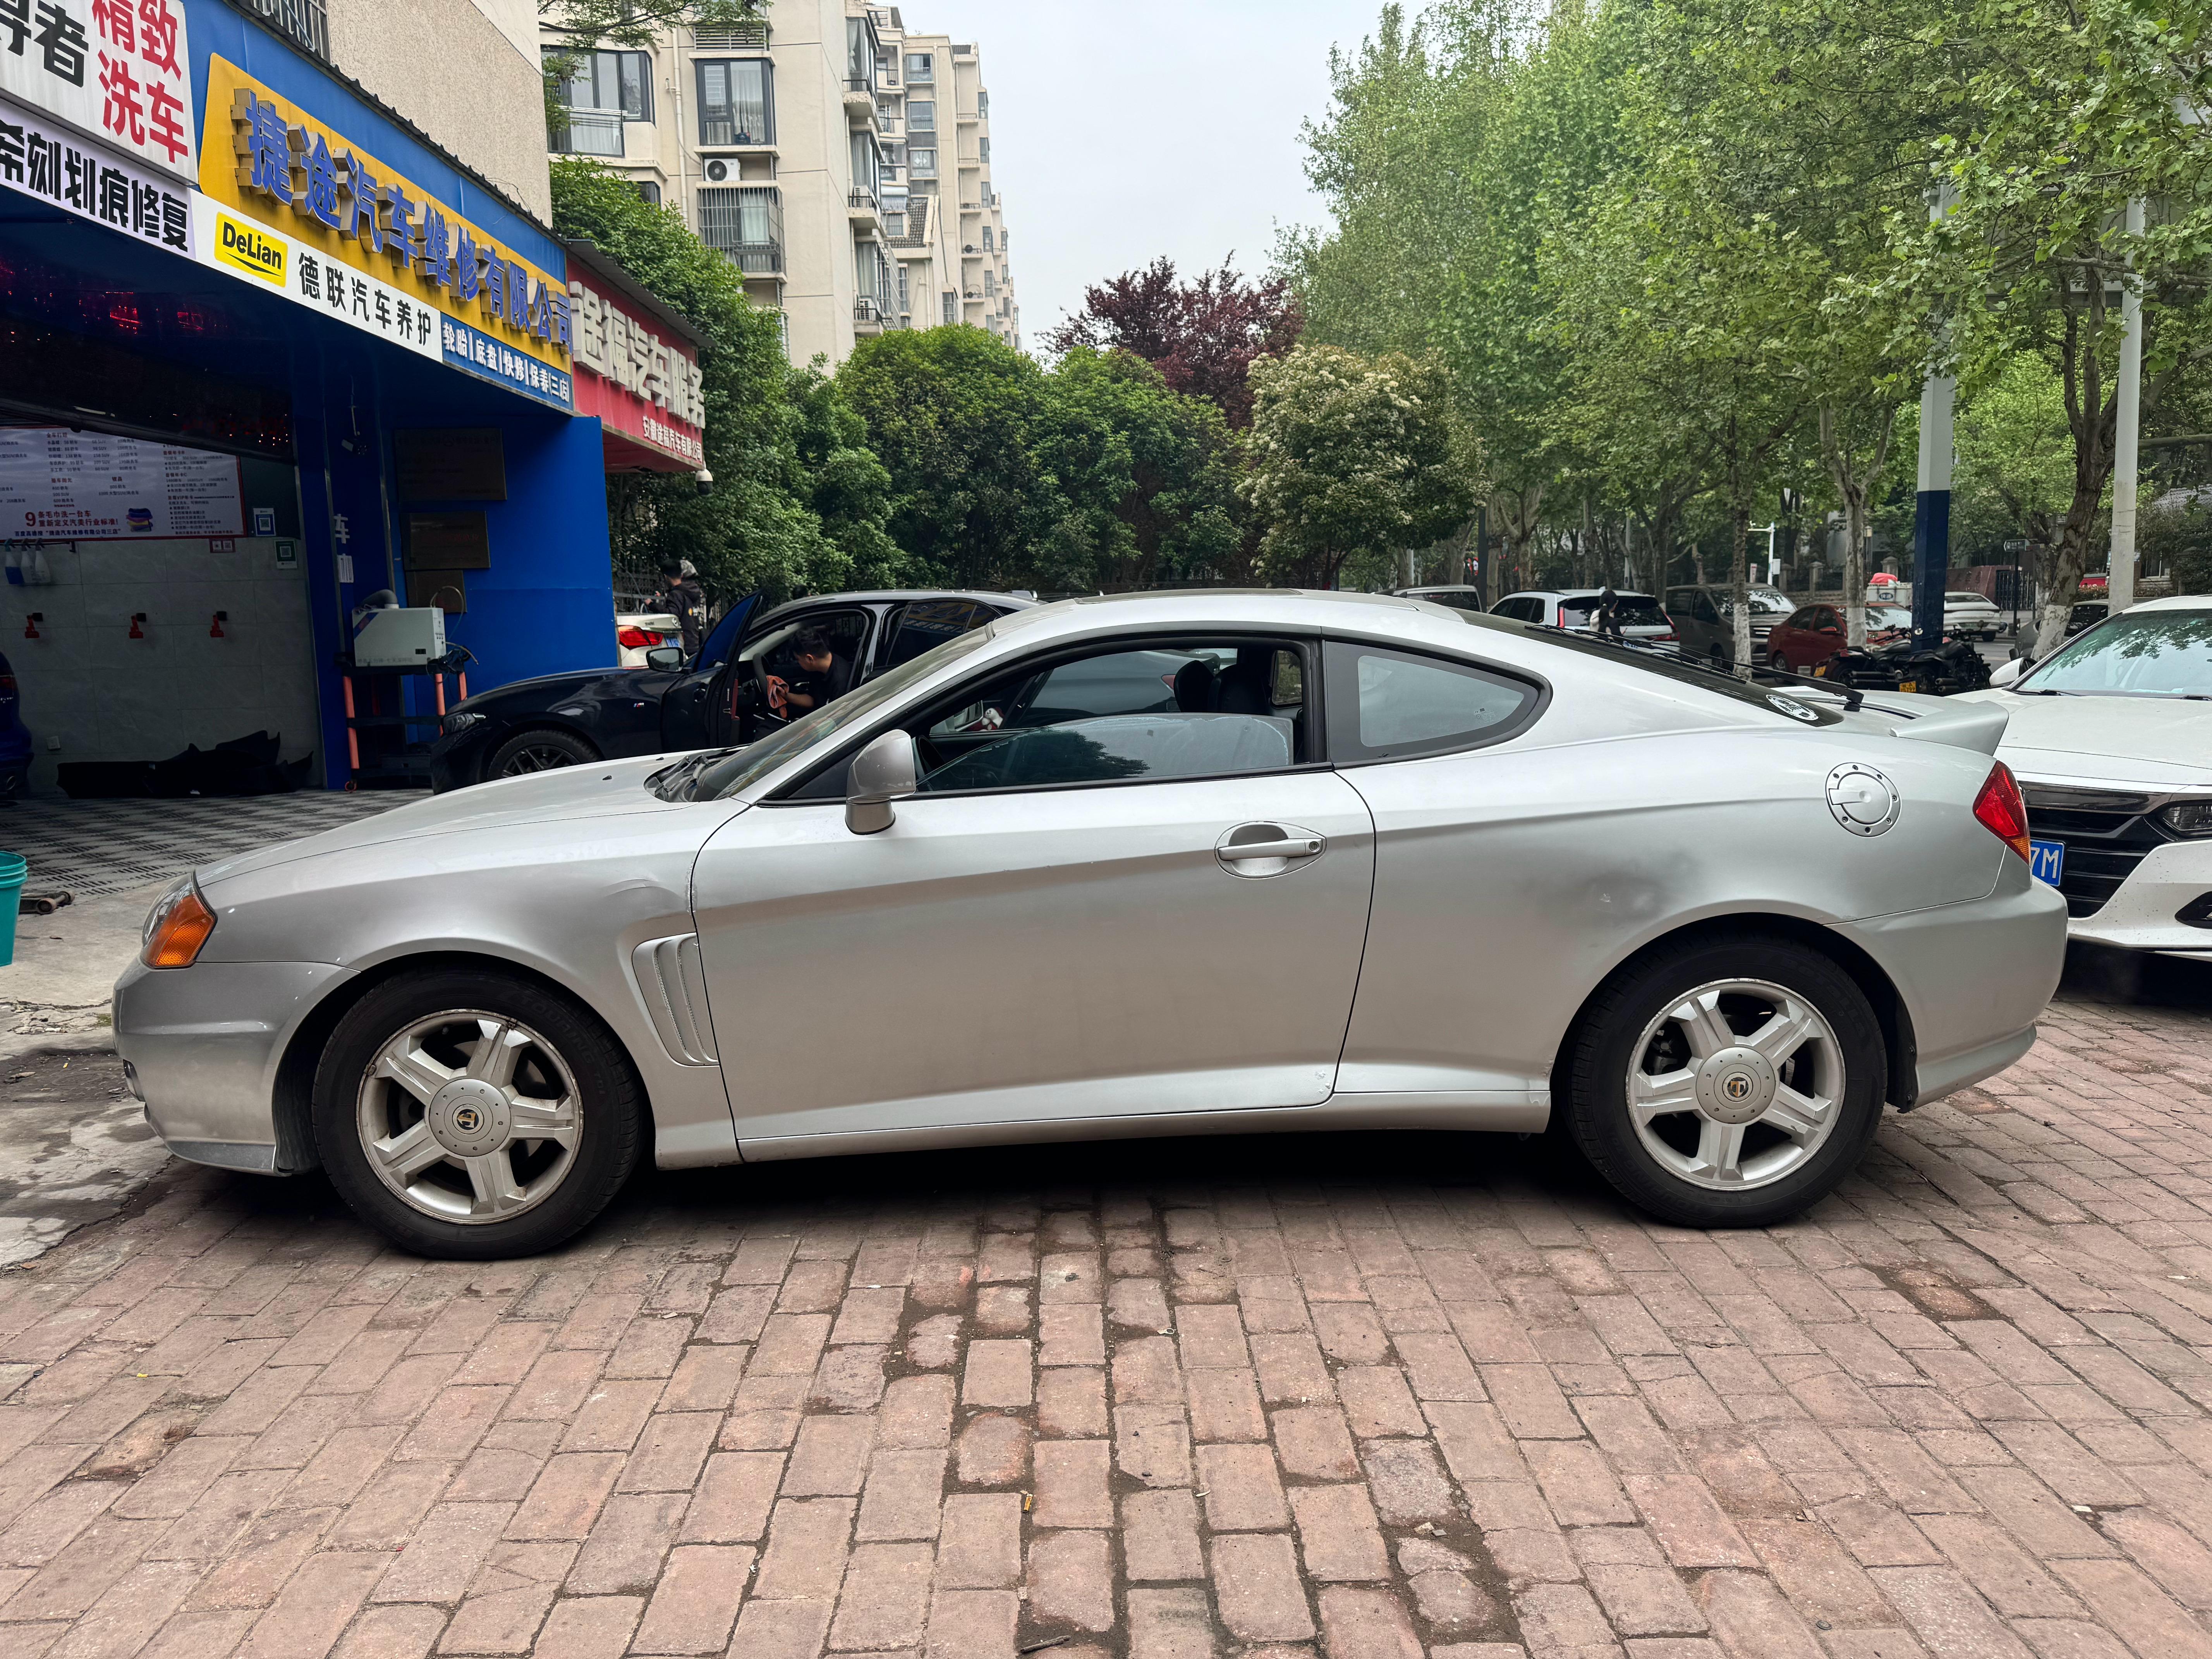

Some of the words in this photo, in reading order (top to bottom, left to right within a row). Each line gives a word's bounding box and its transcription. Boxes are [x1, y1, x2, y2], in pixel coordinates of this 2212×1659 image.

[92, 0, 182, 81] 精致
[98, 49, 188, 164] 洗车
[222, 222, 282, 270] DeLian
[242, 89, 572, 354] 捷途汽车维修有限公司
[299, 252, 431, 346] 德联汽车养护
[570, 281, 705, 429] 途福汽车服务
[643, 416, 702, 462] 安徽途福汽车有限公司
[25, 512, 36, 527] 9
